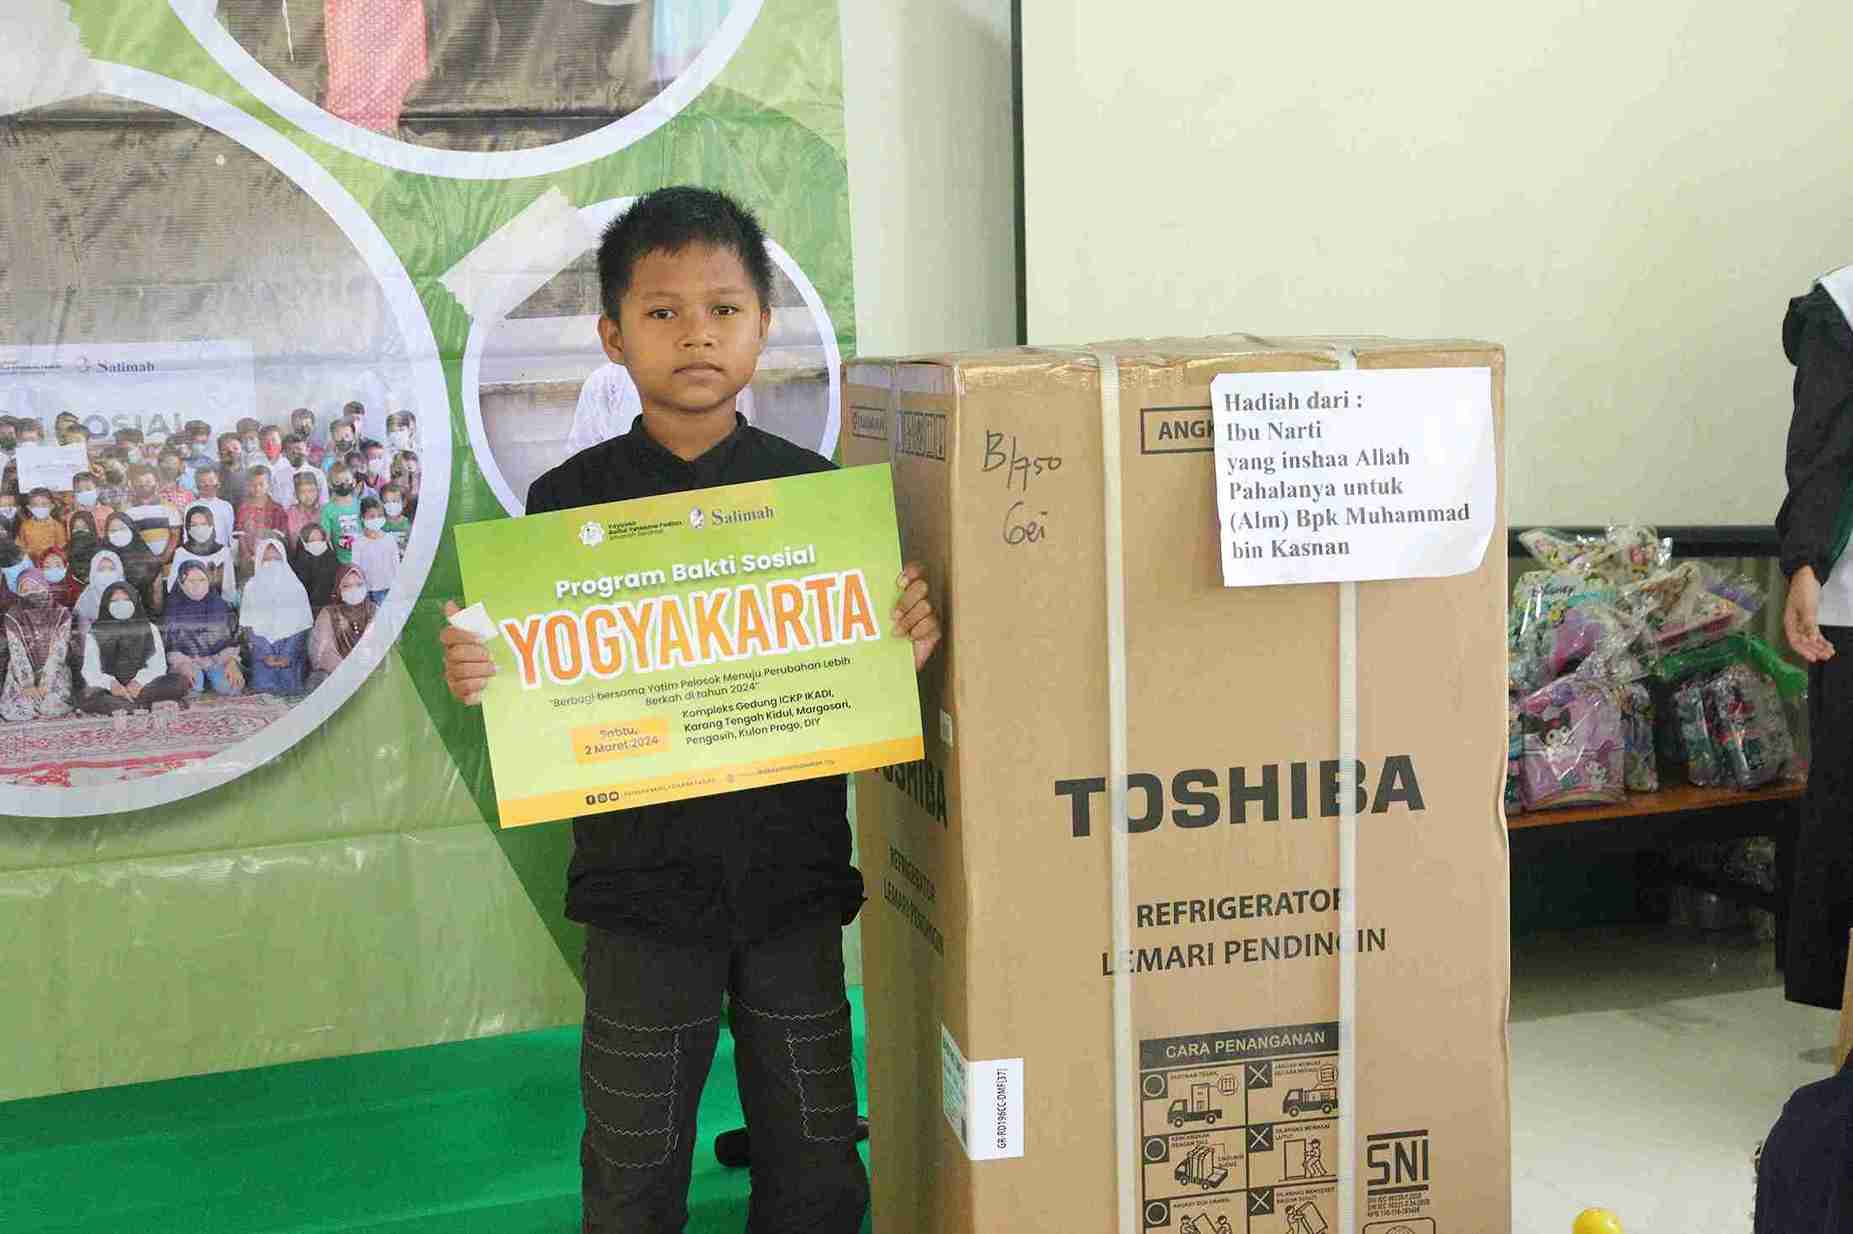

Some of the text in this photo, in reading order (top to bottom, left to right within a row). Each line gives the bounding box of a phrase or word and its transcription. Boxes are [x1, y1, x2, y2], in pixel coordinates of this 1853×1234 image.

[1224, 390, 1363, 412] Hadiah dari :
[1227, 420, 1322, 441] Ibu Narti
[1227, 448, 1410, 475] yang inshaa Allah
[1229, 477, 1403, 502] Pahalanya untuk
[711, 505, 776, 527] Salimah
[1230, 503, 1470, 533] (Alm) Bpk Muhammad
[1232, 539, 1350, 559] bin Kasnan
[555, 544, 816, 599] Program Bakti Sosial
[503, 571, 880, 688] YOGYAKARTA
[597, 686, 646, 700] bersama
[648, 681, 679, 694] Yatim
[680, 674, 720, 689] Pelosok
[723, 669, 762, 682] Menuju
[764, 661, 821, 677] Perubahan
[823, 656, 851, 669] Lebih
[645, 692, 682, 706] Berkah
[684, 690, 695, 700] di
[696, 687, 728, 699] tahun
[681, 688, 834, 719] Kompleks Gedung ICKP IKADI,
[684, 699, 852, 733] Karang Tengah Kidul, Margosari,
[584, 735, 659, 756] 2 Maret 2024
[686, 717, 821, 746] Pengasih, Kulon Progo, DIY
[1053, 754, 1426, 838] TOSHIBA
[1102, 928, 1386, 976] LMARI PENDININ
[1166, 1031, 1325, 1059] CARA PENANGANAN
[1367, 1139, 1428, 1185] SNI
